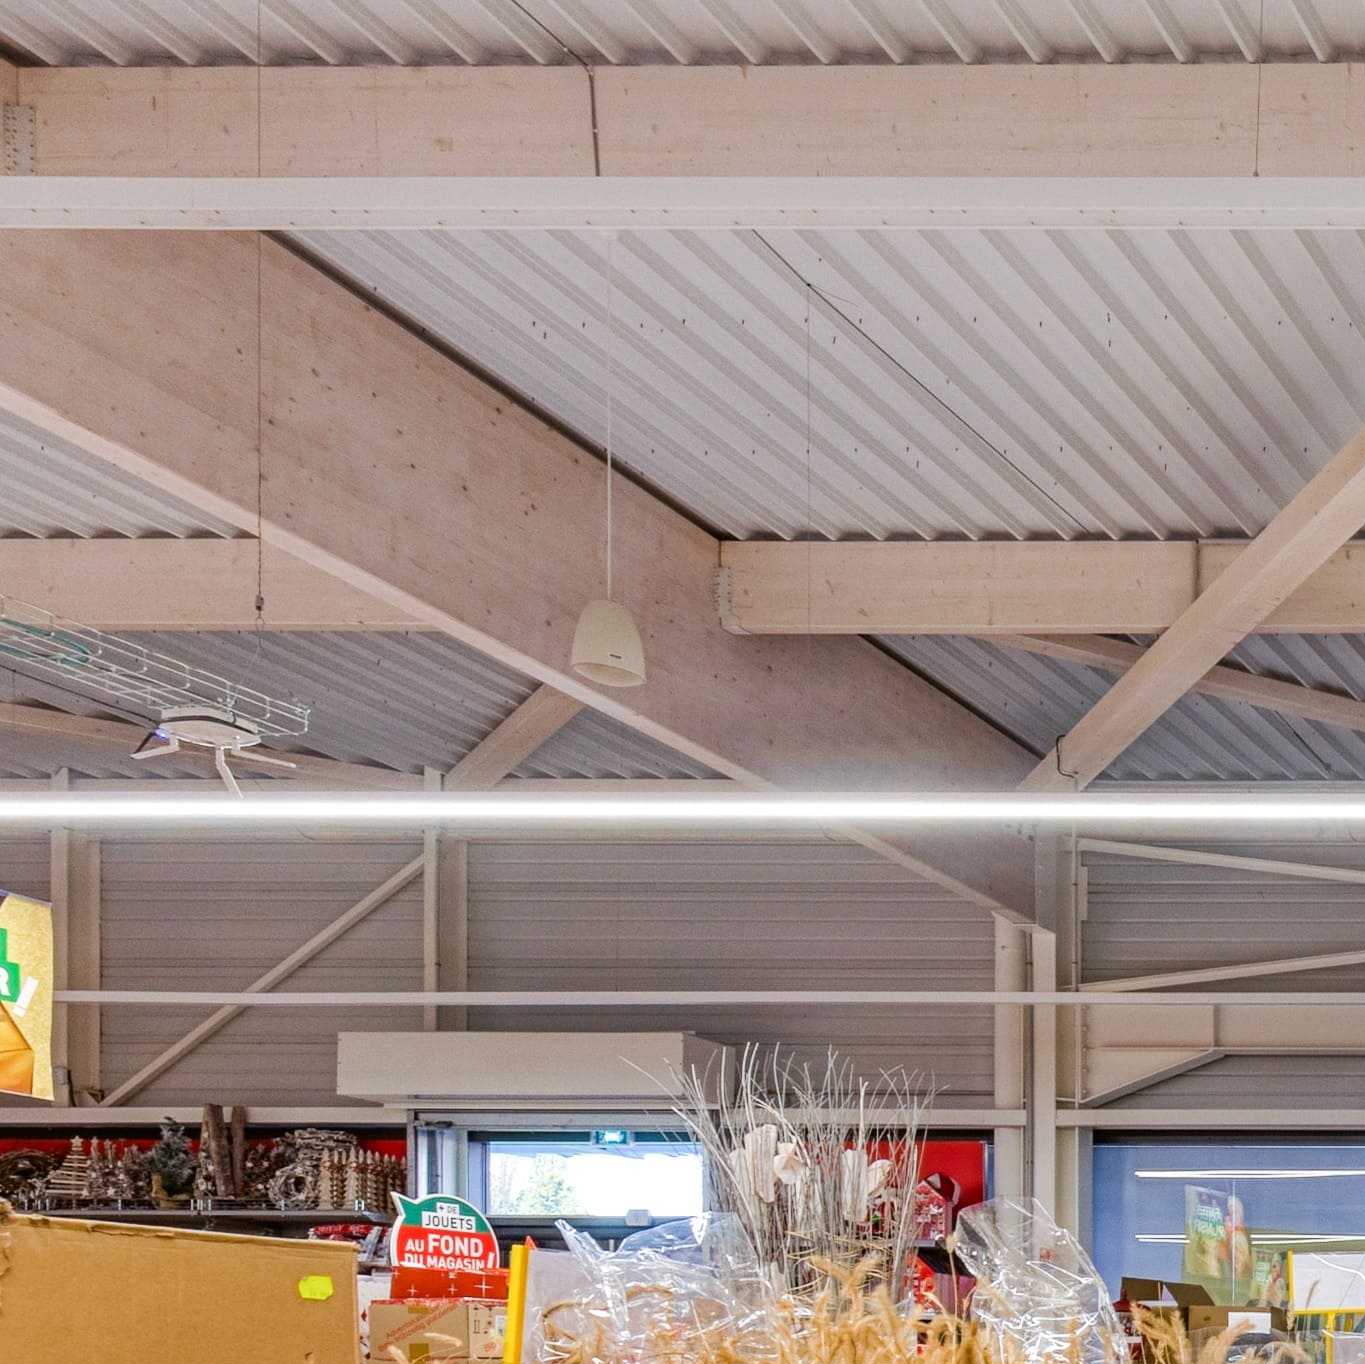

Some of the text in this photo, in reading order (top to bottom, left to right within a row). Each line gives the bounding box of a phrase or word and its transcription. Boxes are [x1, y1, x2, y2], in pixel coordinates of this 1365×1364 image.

[425, 1215, 473, 1231] JOUETS
[405, 1234, 483, 1257] AU FOND
[405, 1253, 424, 1265] DU
[427, 1256, 485, 1271] MAGASIN
